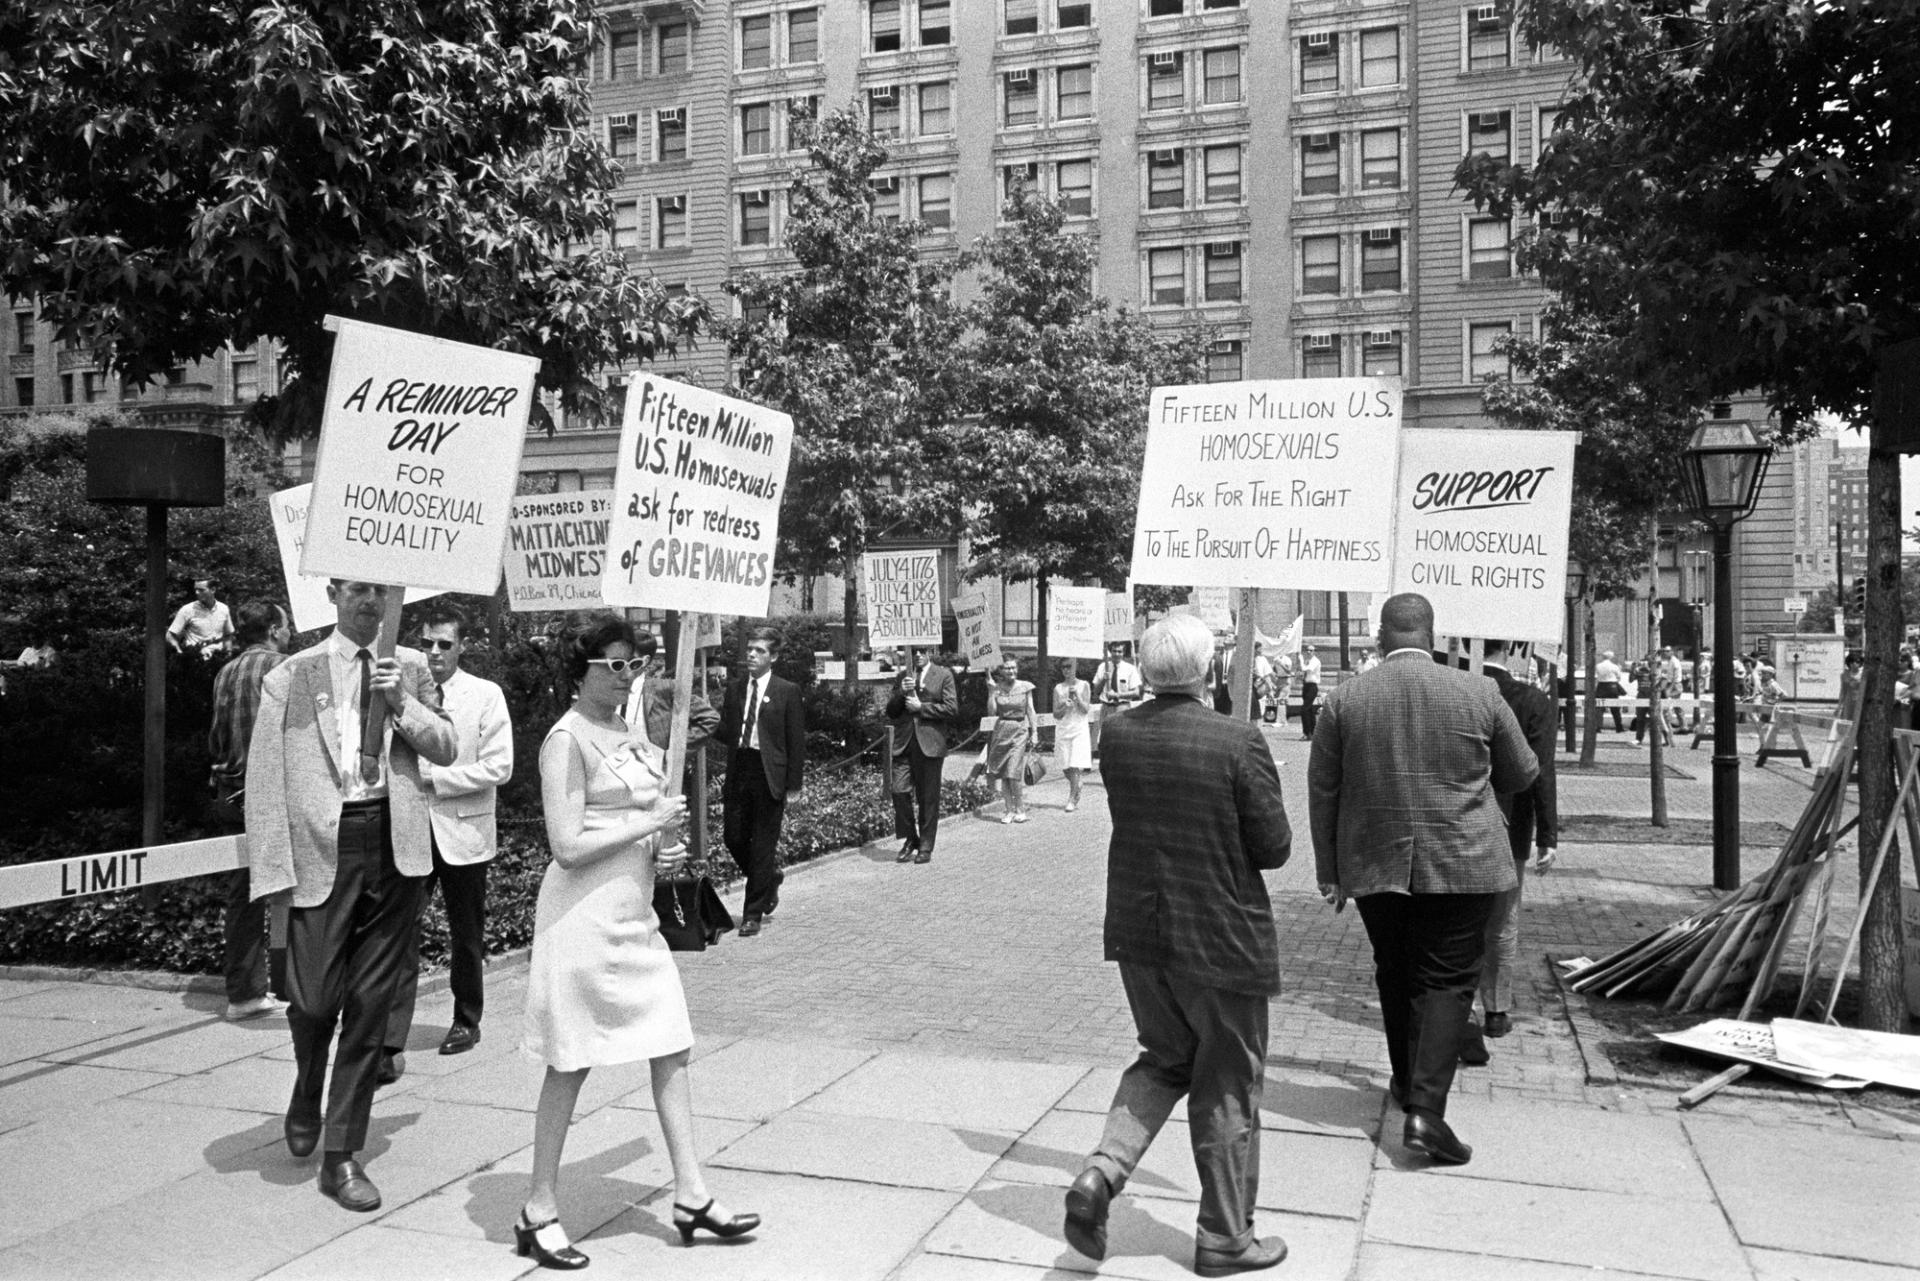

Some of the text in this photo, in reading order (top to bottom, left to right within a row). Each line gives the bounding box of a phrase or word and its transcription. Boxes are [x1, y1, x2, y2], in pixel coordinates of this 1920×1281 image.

[343, 377, 518, 418] A REMINDER
[1348, 391, 1393, 418] U.S.
[387, 419, 460, 455] DAY
[639, 381, 774, 456] Fifteen Million
[1200, 432, 1340, 461] HOMOSEXUALS
[396, 463, 444, 488] FOR
[635, 432, 777, 500] U.S. Homosexuals
[344, 483, 486, 525] HOMOSEXUAL
[1412, 467, 1554, 510] SUPPORT
[510, 499, 611, 519] O-SPONSORED BY:
[627, 487, 761, 541] ask for redress
[345, 516, 460, 553] EQUALITY
[1415, 529, 1547, 556] HOMOSEXUAL
[620, 537, 769, 587] of GRIEVANCES
[1411, 562, 1545, 589] CIVIL RIGHTS
[920, 602, 936, 618] IT
[61, 852, 148, 896] LIMIT
